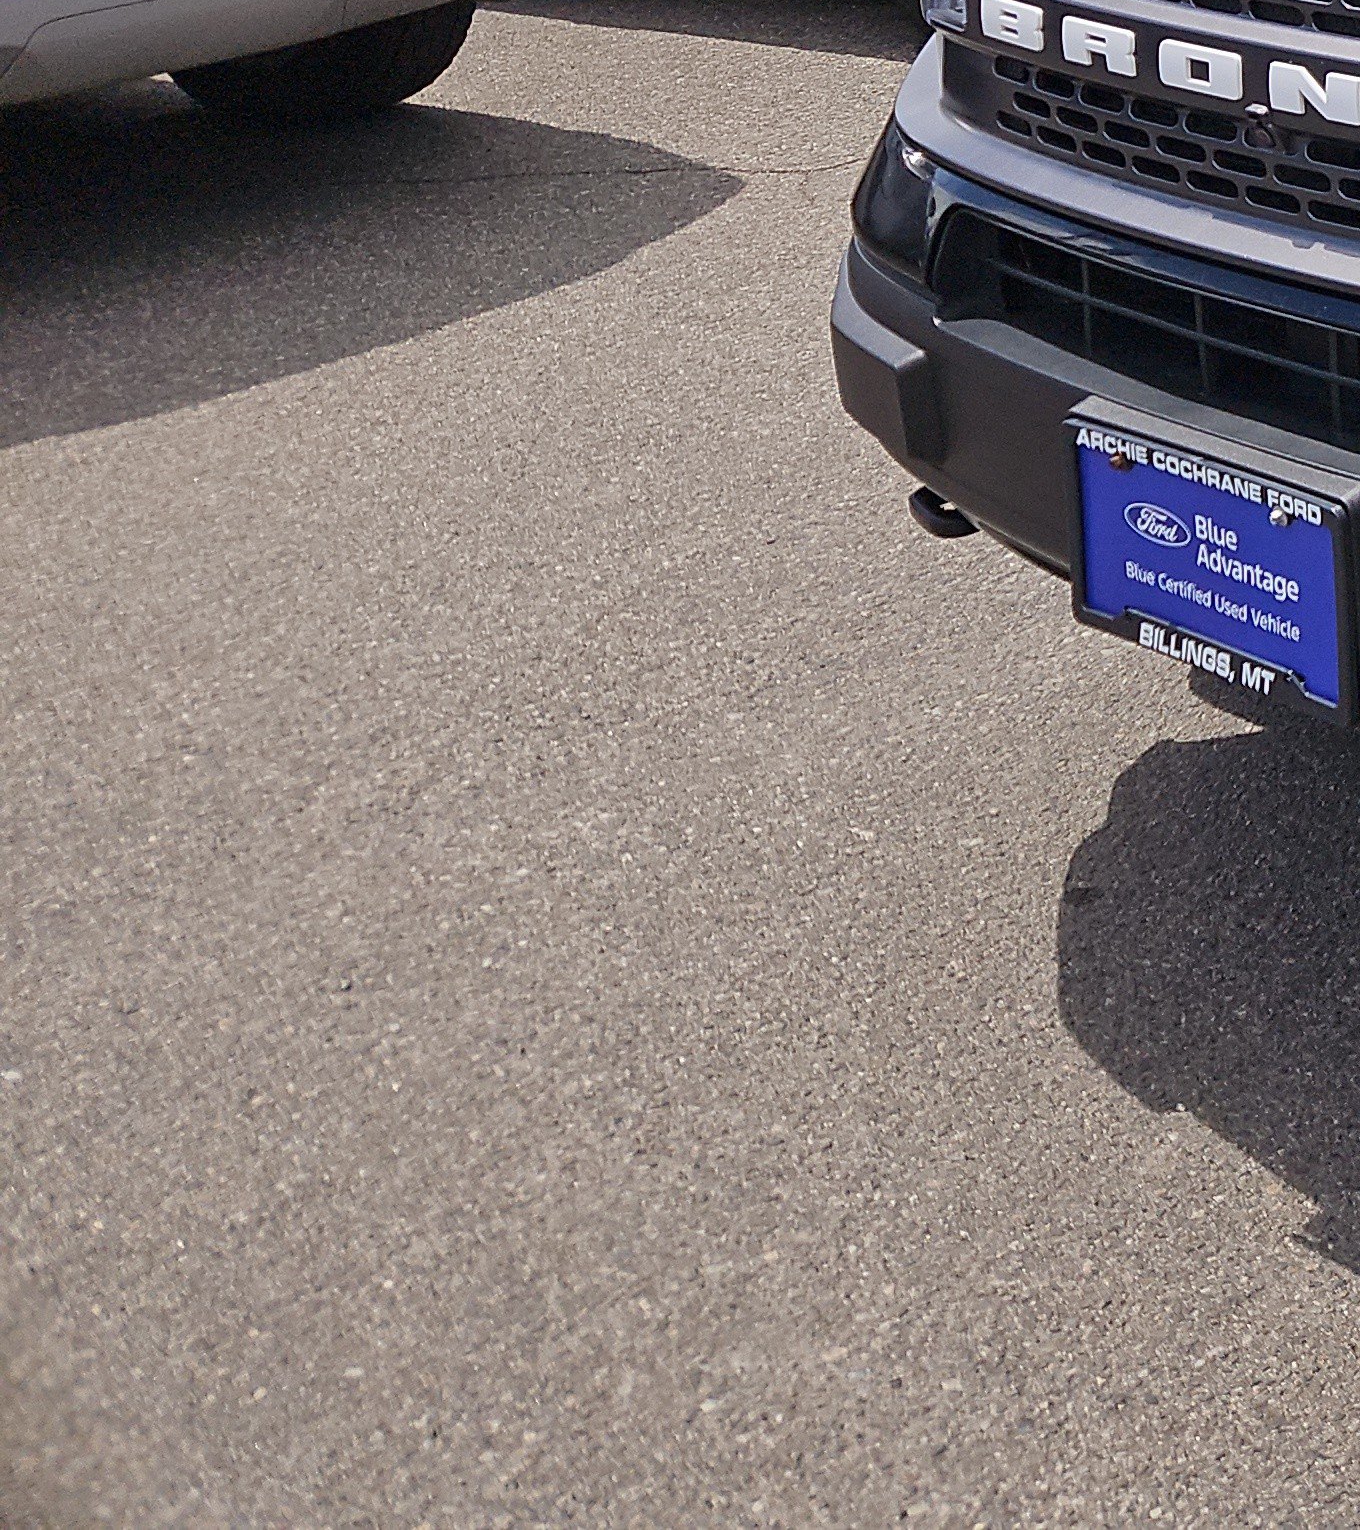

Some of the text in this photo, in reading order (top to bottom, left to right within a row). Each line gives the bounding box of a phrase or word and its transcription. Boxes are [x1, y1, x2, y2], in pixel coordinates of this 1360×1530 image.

[1076, 428, 1323, 526] ARCHIE COCHRANE FORD
[1137, 506, 1238, 552] Ford Blue
[1125, 560, 1301, 643] Blue Certified Used Vehicle
[1196, 544, 1300, 604] Advantage
[1138, 622, 1277, 696] BILLINGS, MT
